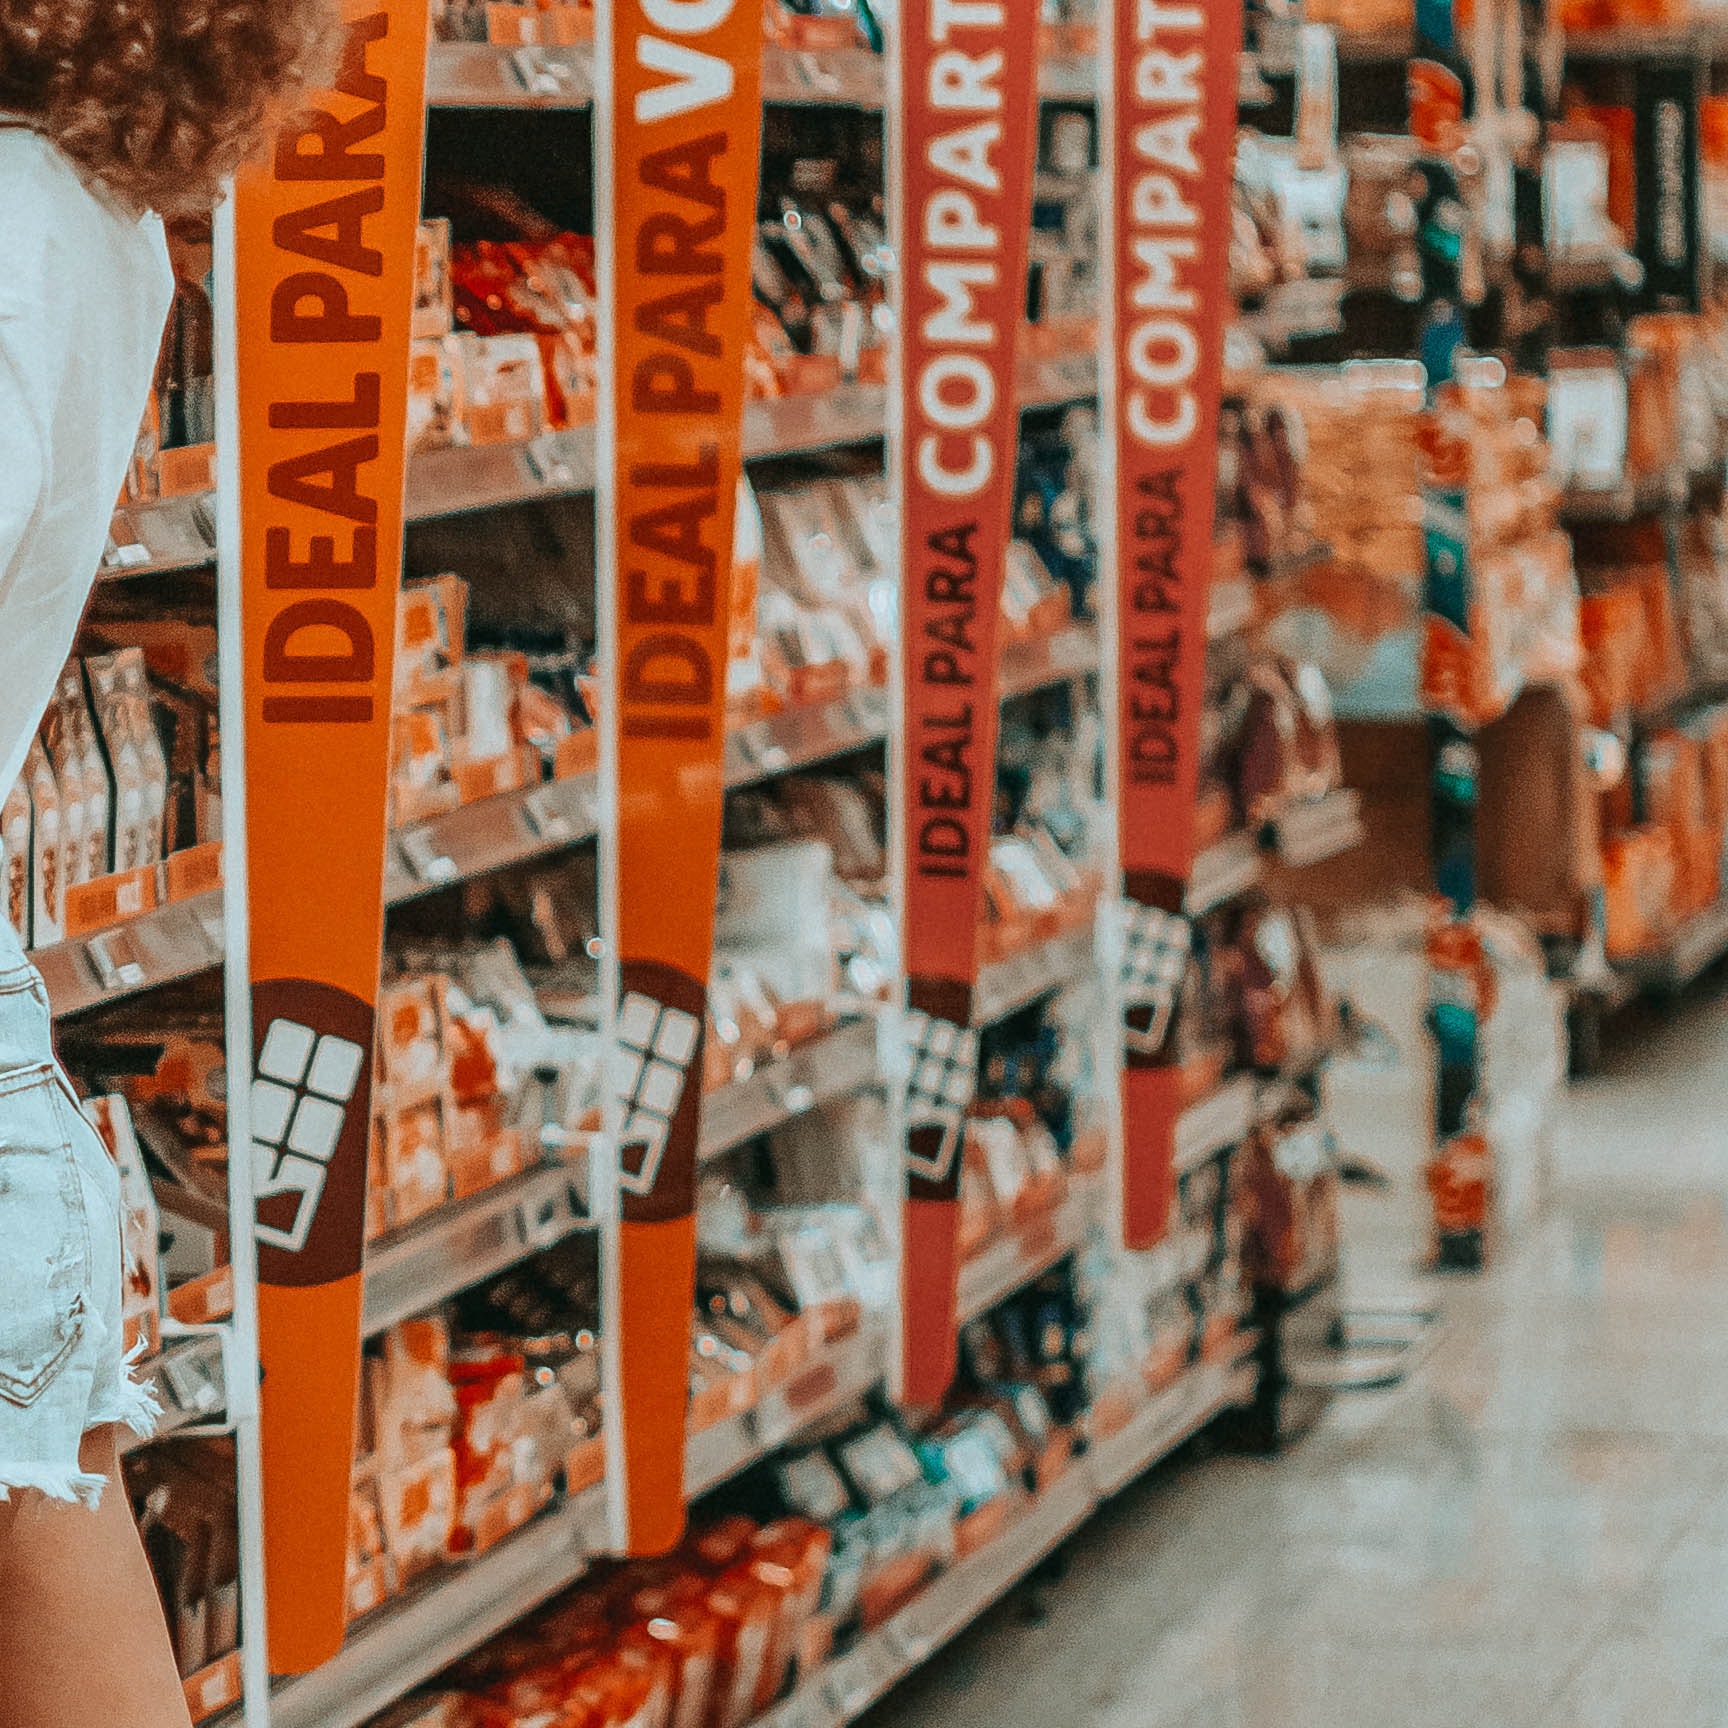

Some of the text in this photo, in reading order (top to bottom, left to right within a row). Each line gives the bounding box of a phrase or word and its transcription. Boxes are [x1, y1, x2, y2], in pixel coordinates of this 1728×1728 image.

[632, 129, 730, 416] PARA
[263, 371, 381, 726] IDEAL
[623, 440, 722, 743] IDEAL
[920, 517, 980, 695] PARA
[1132, 469, 1188, 626] PARA
[917, 702, 973, 880] IDEAL
[1132, 629, 1180, 787] IDEAL
